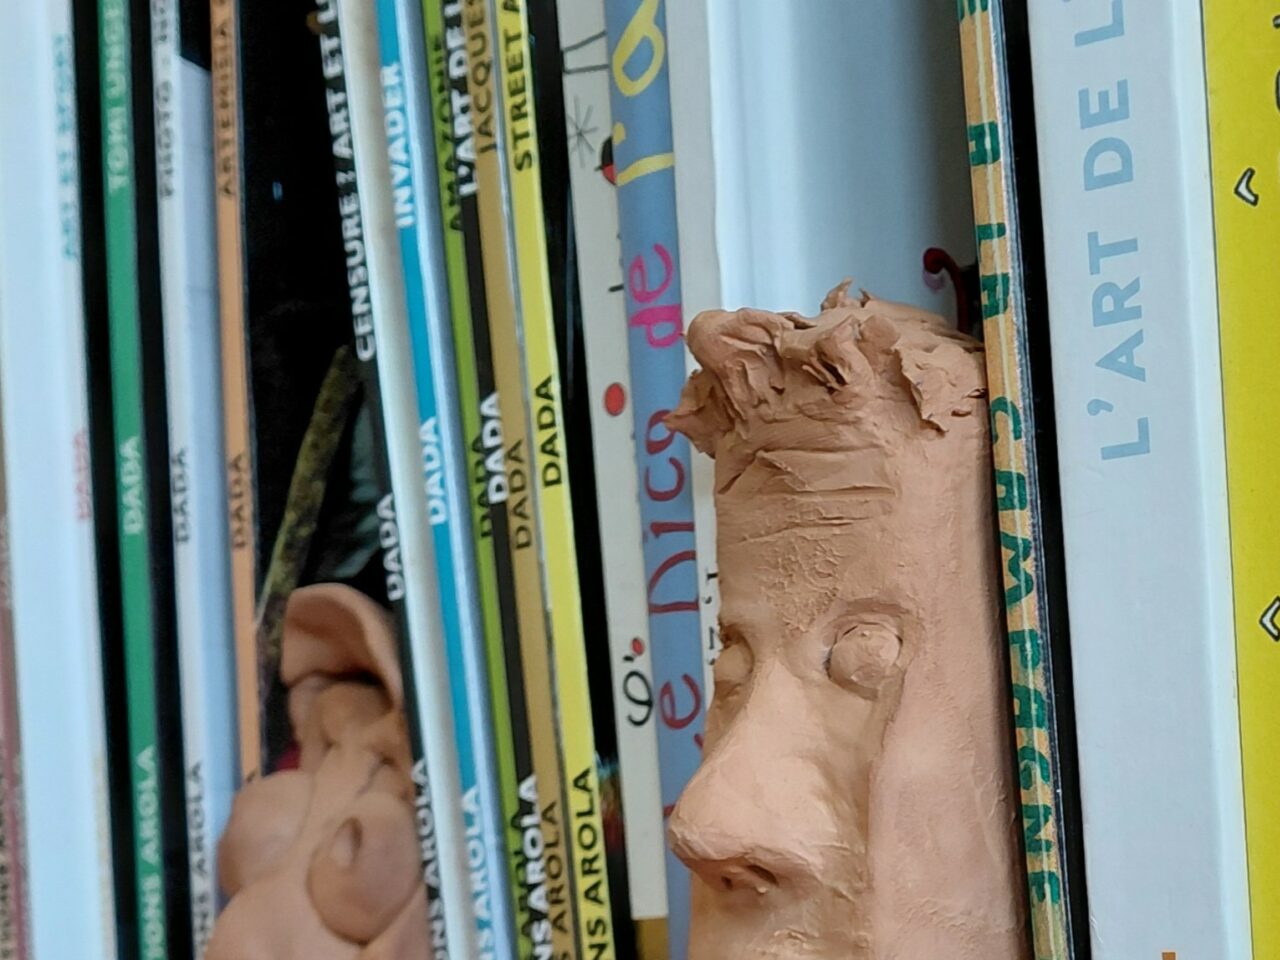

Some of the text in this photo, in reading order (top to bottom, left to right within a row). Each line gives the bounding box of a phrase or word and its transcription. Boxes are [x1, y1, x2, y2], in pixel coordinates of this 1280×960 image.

[446, 27, 468, 80] DE
[466, 0, 498, 155] JACQUE
[503, 29, 533, 173] STREET
[380, 63, 415, 229] INVADER
[451, 89, 480, 197] L'ART
[1077, 79, 1135, 192] DE
[628, 242, 685, 348] de
[1087, 231, 1151, 461] L'ART
[119, 435, 145, 536] DADA
[420, 416, 448, 526] DADA
[481, 392, 510, 504] DADA
[533, 373, 564, 489] DADA
[171, 447, 190, 544] DADA
[227, 452, 248, 549] DADA
[376, 492, 405, 601] DADA
[507, 439, 533, 550] DADA
[990, 395, 1060, 906] CAMPAGNE
[136, 744, 161, 868] AROLA
[410, 759, 441, 889] AROLA
[462, 784, 492, 919] AROLA
[518, 774, 550, 914] AROLA
[572, 766, 605, 906] AROLA
[541, 800, 568, 934] AROLA
